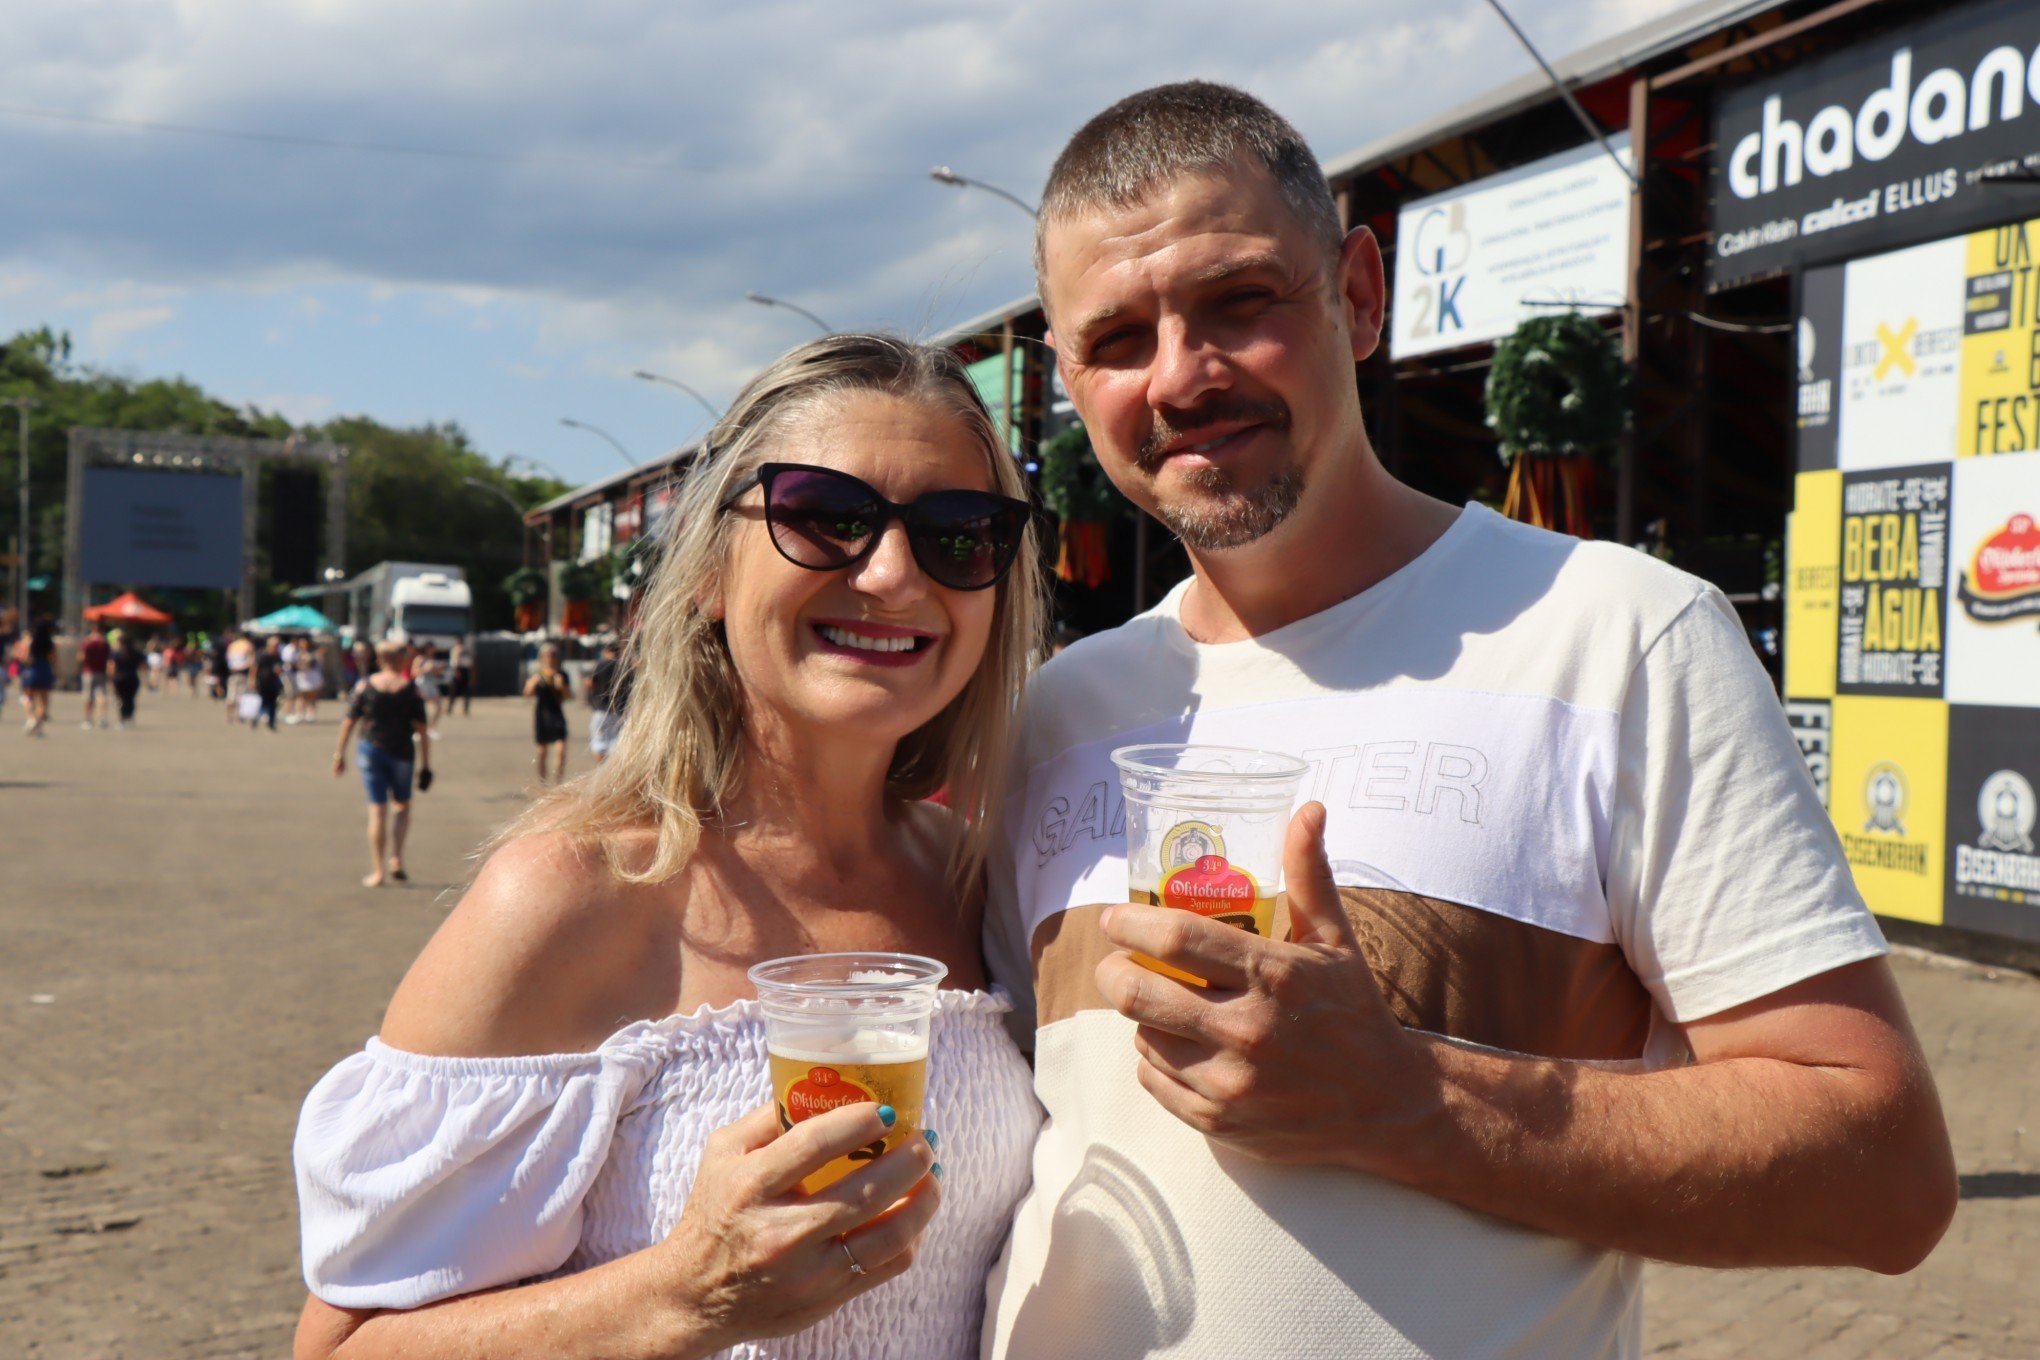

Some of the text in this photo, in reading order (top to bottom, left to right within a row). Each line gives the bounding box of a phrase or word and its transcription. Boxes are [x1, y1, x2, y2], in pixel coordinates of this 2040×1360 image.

[1884, 168, 1958, 214] ELLUS
[1843, 512, 1919, 583] BEBA
[1033, 741, 1489, 857] GATER
[1170, 880, 1249, 898] Oktoberfest
[1190, 898, 1231, 910] Igrejinha
